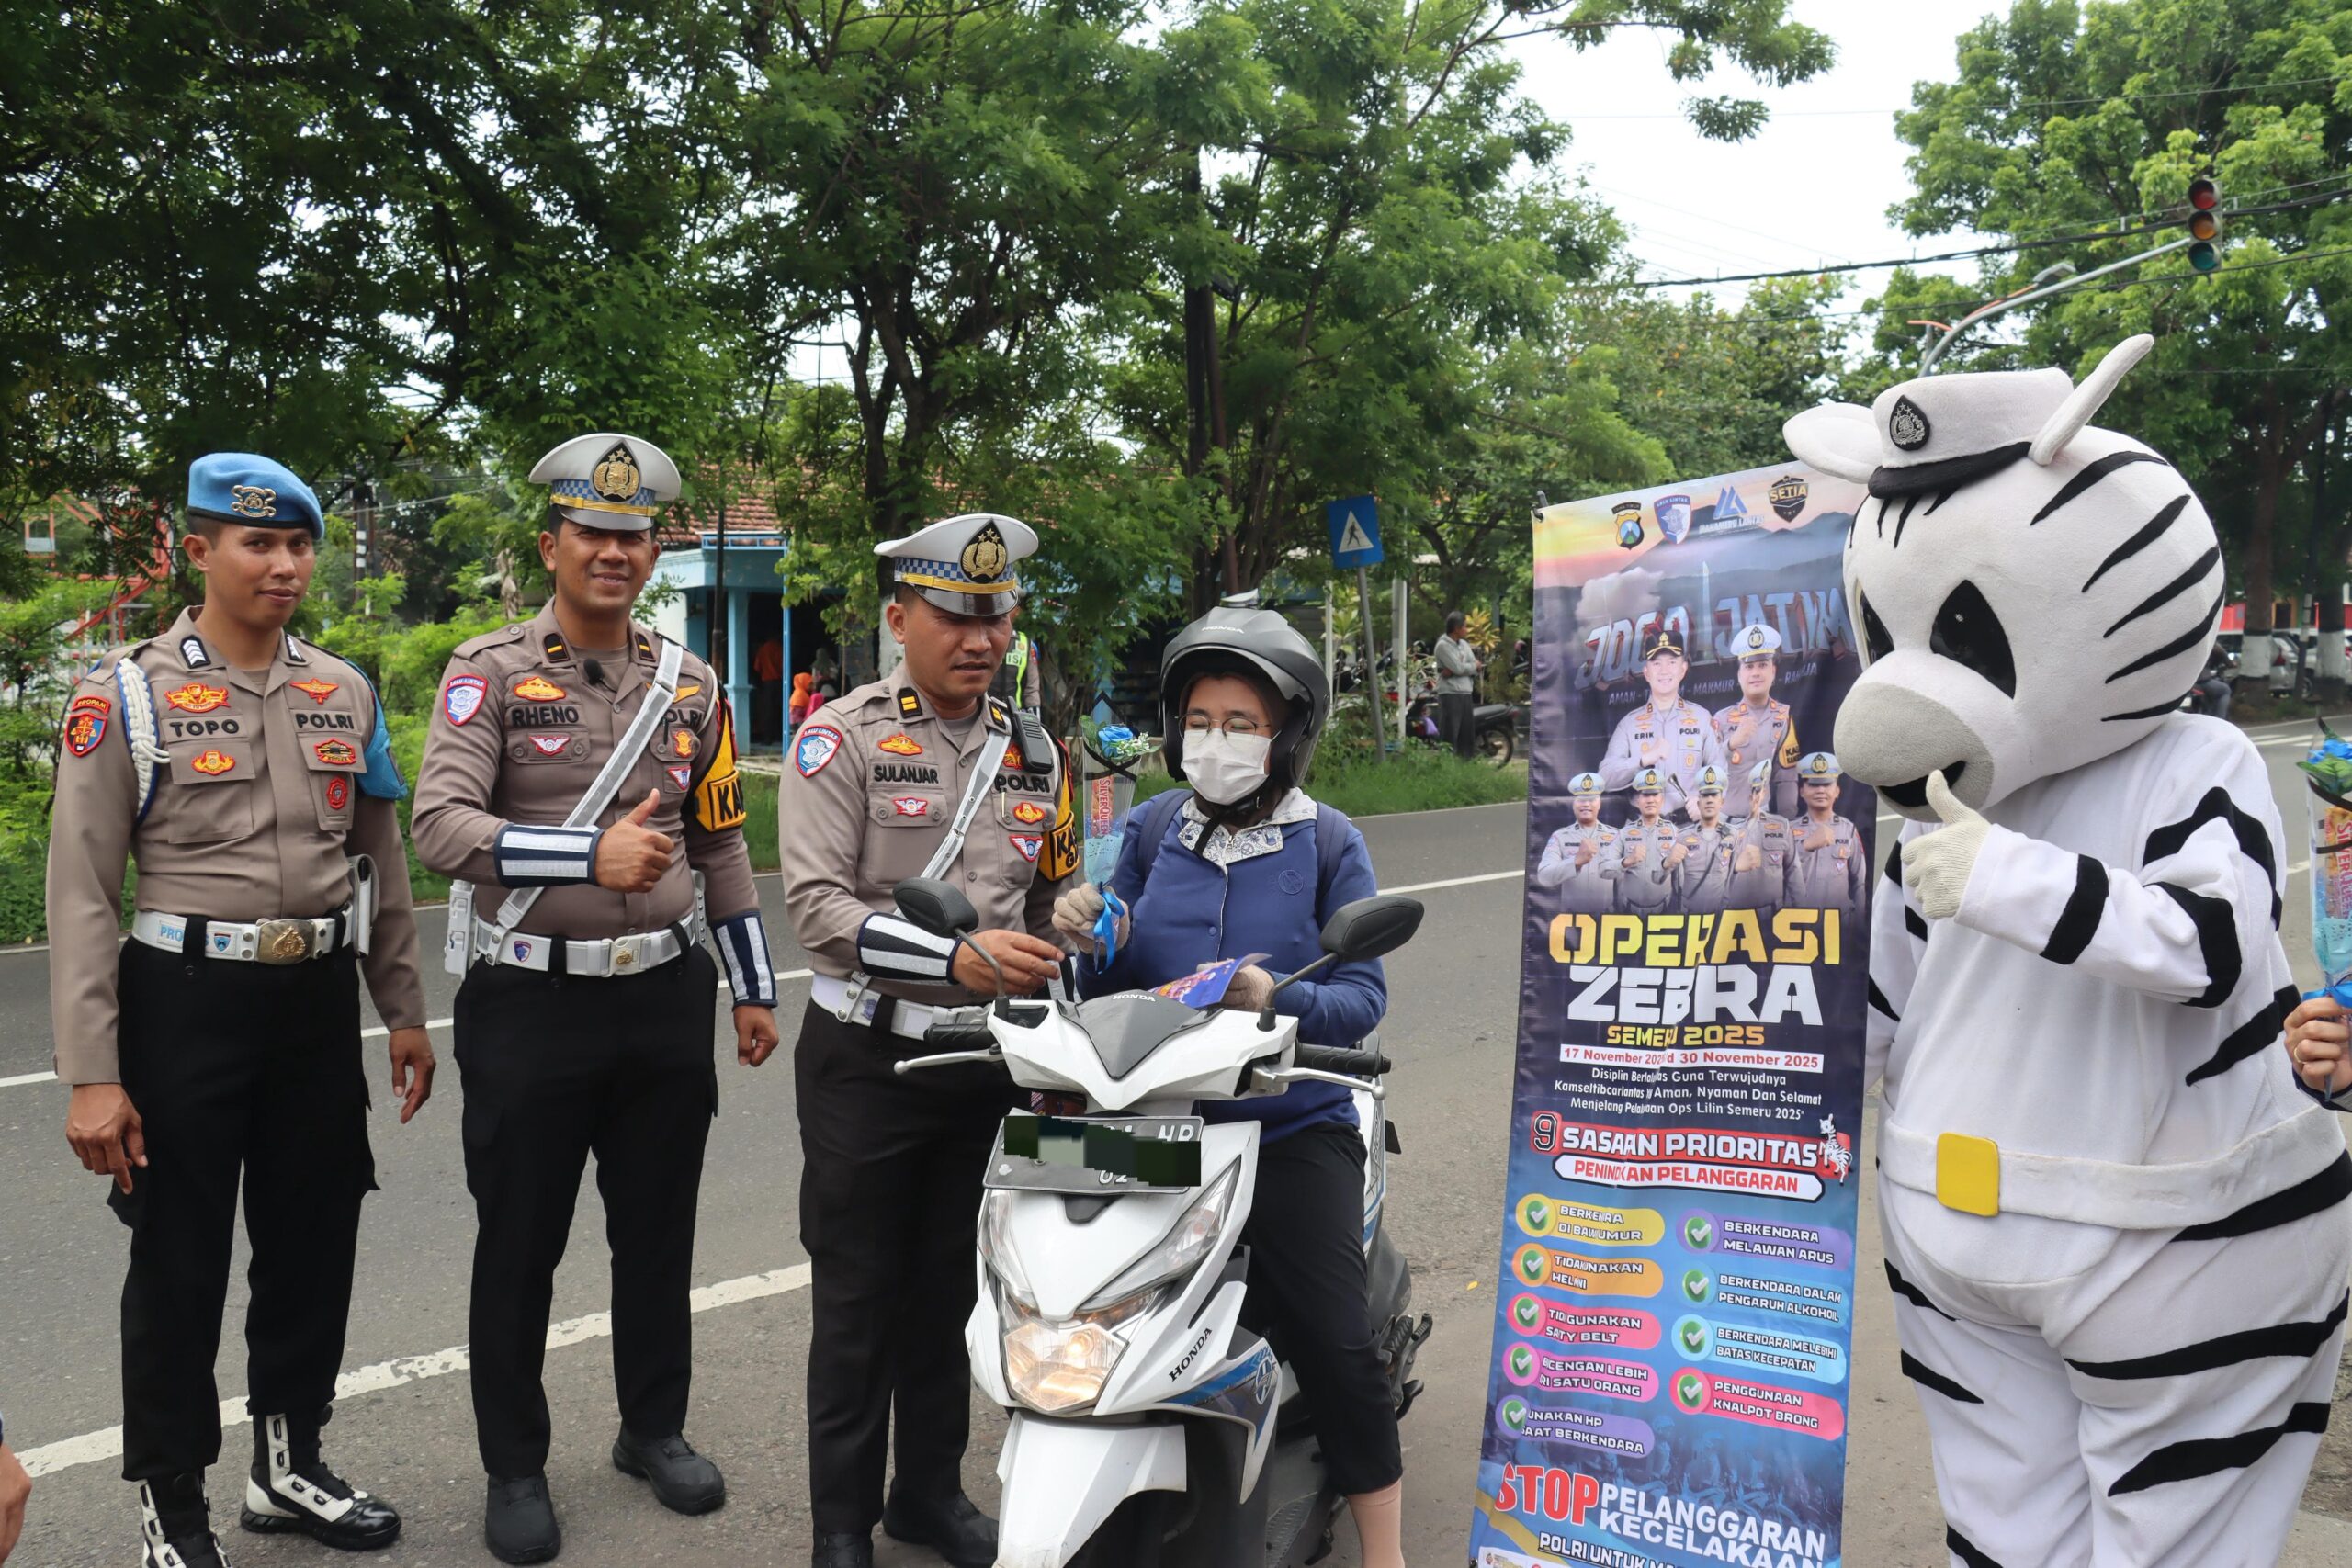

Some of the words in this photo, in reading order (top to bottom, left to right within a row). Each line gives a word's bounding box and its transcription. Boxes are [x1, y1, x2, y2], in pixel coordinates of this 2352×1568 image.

[1770, 485, 1807, 502] SETIA
[464, 678, 485, 687] LINTAS
[1609, 691, 1636, 705] AMAN
[1693, 679, 1735, 695] MAKMUR
[77, 699, 107, 709] PROPAM
[295, 713, 355, 729] POLRI
[512, 706, 579, 727] RHENO
[663, 708, 703, 728] OLRI
[169, 718, 239, 737] TOPO
[804, 728, 818, 736] LALU
[818, 727, 838, 740] LINTAS
[1634, 731, 1654, 739] ERIK
[874, 765, 940, 784] SULANJAR
[994, 774, 1050, 793] POLRI
[1548, 908, 1840, 967] OPERASI
[1112, 993, 1156, 1002] HONDA
[1567, 964, 1823, 1026] ZEBRA
[1683, 1025, 1765, 1046] 2025
[1564, 1048, 1580, 1058] 17
[1584, 1050, 1642, 1065] November
[1679, 1052, 1699, 1064] 30
[1703, 1052, 1781, 1066] November
[1784, 1055, 1818, 1068] 2025
[1591, 1067, 1629, 1082] Disiplin
[1671, 1071, 1704, 1083] Guna
[1709, 1069, 1786, 1087] Terwujudnya
[1555, 1079, 1645, 1099] Kamseltibcarlantas
[1654, 1086, 1693, 1100] Aman,
[1697, 1086, 1747, 1100] Nyaman
[1752, 1089, 1776, 1101] Dan
[1780, 1090, 1822, 1106] Selamat
[1570, 1097, 1623, 1115] Menjelang
[1668, 1103, 1692, 1115] Ops
[1697, 1101, 1724, 1114] Lilin
[1727, 1103, 1771, 1118] Semeru
[1533, 1112, 1558, 1152] 9
[1665, 1132, 1818, 1168] PRIORITAS
[1657, 1166, 1799, 1193] PELANGGARAN
[1558, 1223, 1571, 1234] DI
[1724, 1220, 1820, 1244] BERKENDARA
[1724, 1239, 1795, 1259] MELAWAN
[1798, 1248, 1835, 1265] ARUS
[1719, 1274, 1802, 1296] BERKENDARA
[1803, 1285, 1842, 1304] DALAM
[1718, 1292, 1785, 1312] PENGARUH
[1580, 1332, 1619, 1344] BELT
[1716, 1327, 1791, 1349] BERKENDARA
[1792, 1340, 1838, 1359] MELEBIHI
[1168, 1326, 1213, 1382] HONDA
[1716, 1346, 1752, 1360] BATAS
[1752, 1351, 1816, 1373] KECEPATAN
[1607, 1362, 1648, 1381] LEBIH
[1553, 1376, 1592, 1388] SATU
[1593, 1379, 1642, 1397] ORANG
[1714, 1381, 1804, 1406] PENGGUNAAN
[1585, 1416, 1603, 1428] HP
[1713, 1398, 1773, 1419] KNALPOT
[1774, 1411, 1819, 1429] BRONG
[1555, 1427, 1645, 1455] BERKENDARA
[1494, 1461, 1600, 1527] STOP
[1601, 1483, 1826, 1562] PELANGGARAN
[1538, 1531, 1589, 1560] POLRI
[1589, 1543, 1649, 1568] UNTUK
